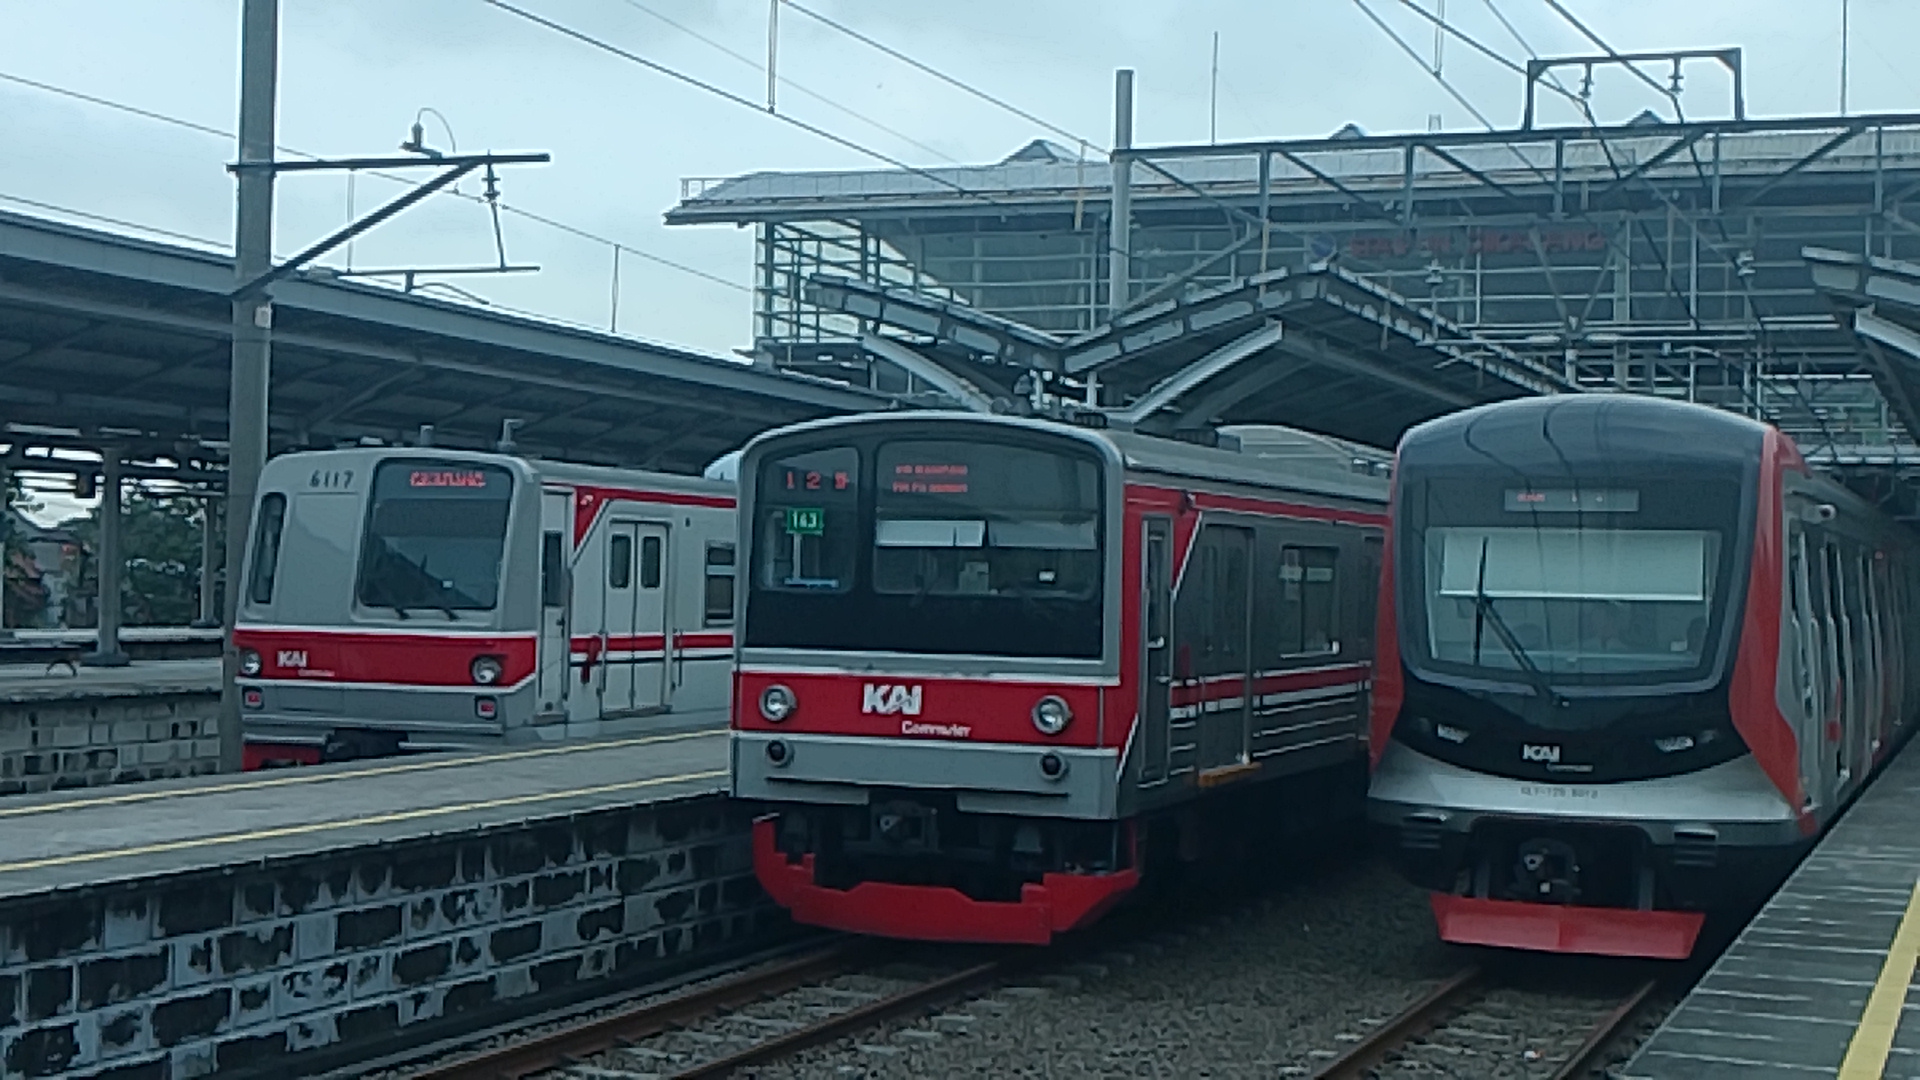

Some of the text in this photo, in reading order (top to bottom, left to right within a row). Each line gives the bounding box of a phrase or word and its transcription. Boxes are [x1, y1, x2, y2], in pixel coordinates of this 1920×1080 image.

[309, 468, 355, 489] 6117
[276, 649, 309, 668] KAI
[862, 683, 923, 715] KAI
[1522, 743, 1561, 763] KAI
